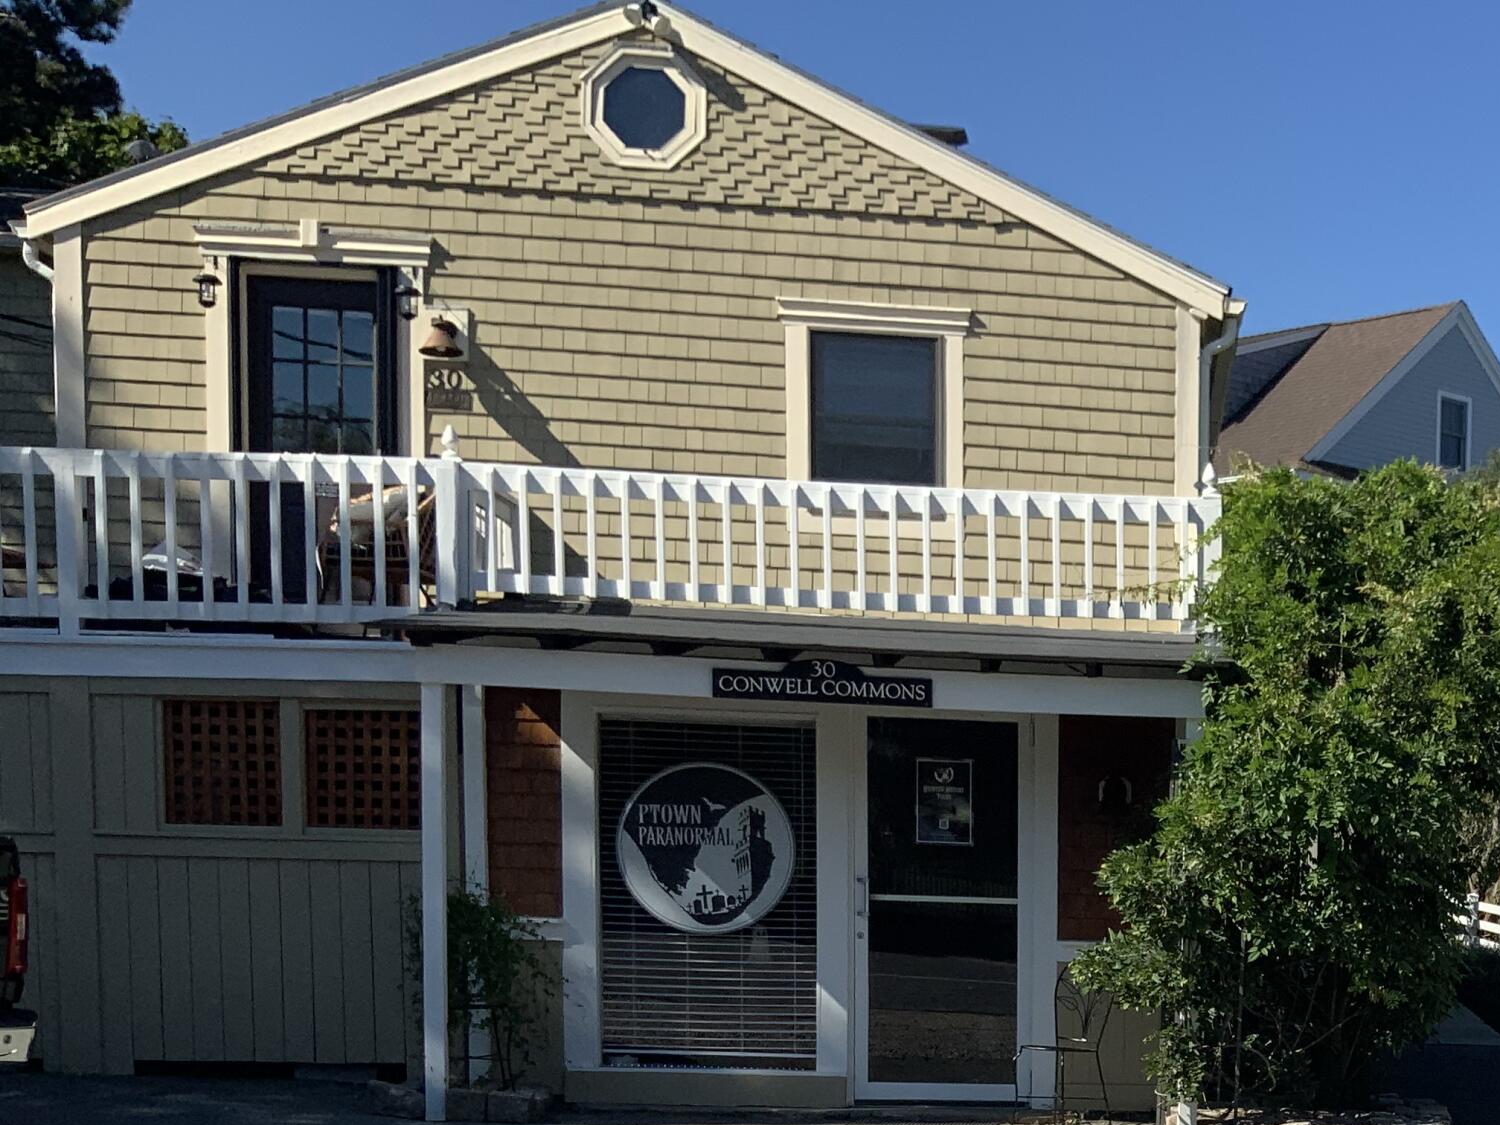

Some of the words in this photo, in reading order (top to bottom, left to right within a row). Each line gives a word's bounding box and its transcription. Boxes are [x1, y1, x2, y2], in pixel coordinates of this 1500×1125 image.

[428, 369, 463, 390] 30
[810, 660, 836, 678] 30
[718, 674, 818, 696] CONWELL
[821, 679, 926, 701] COMMONS
[638, 803, 701, 825] PTOWN
[638, 825, 735, 847] PARANORMAL
